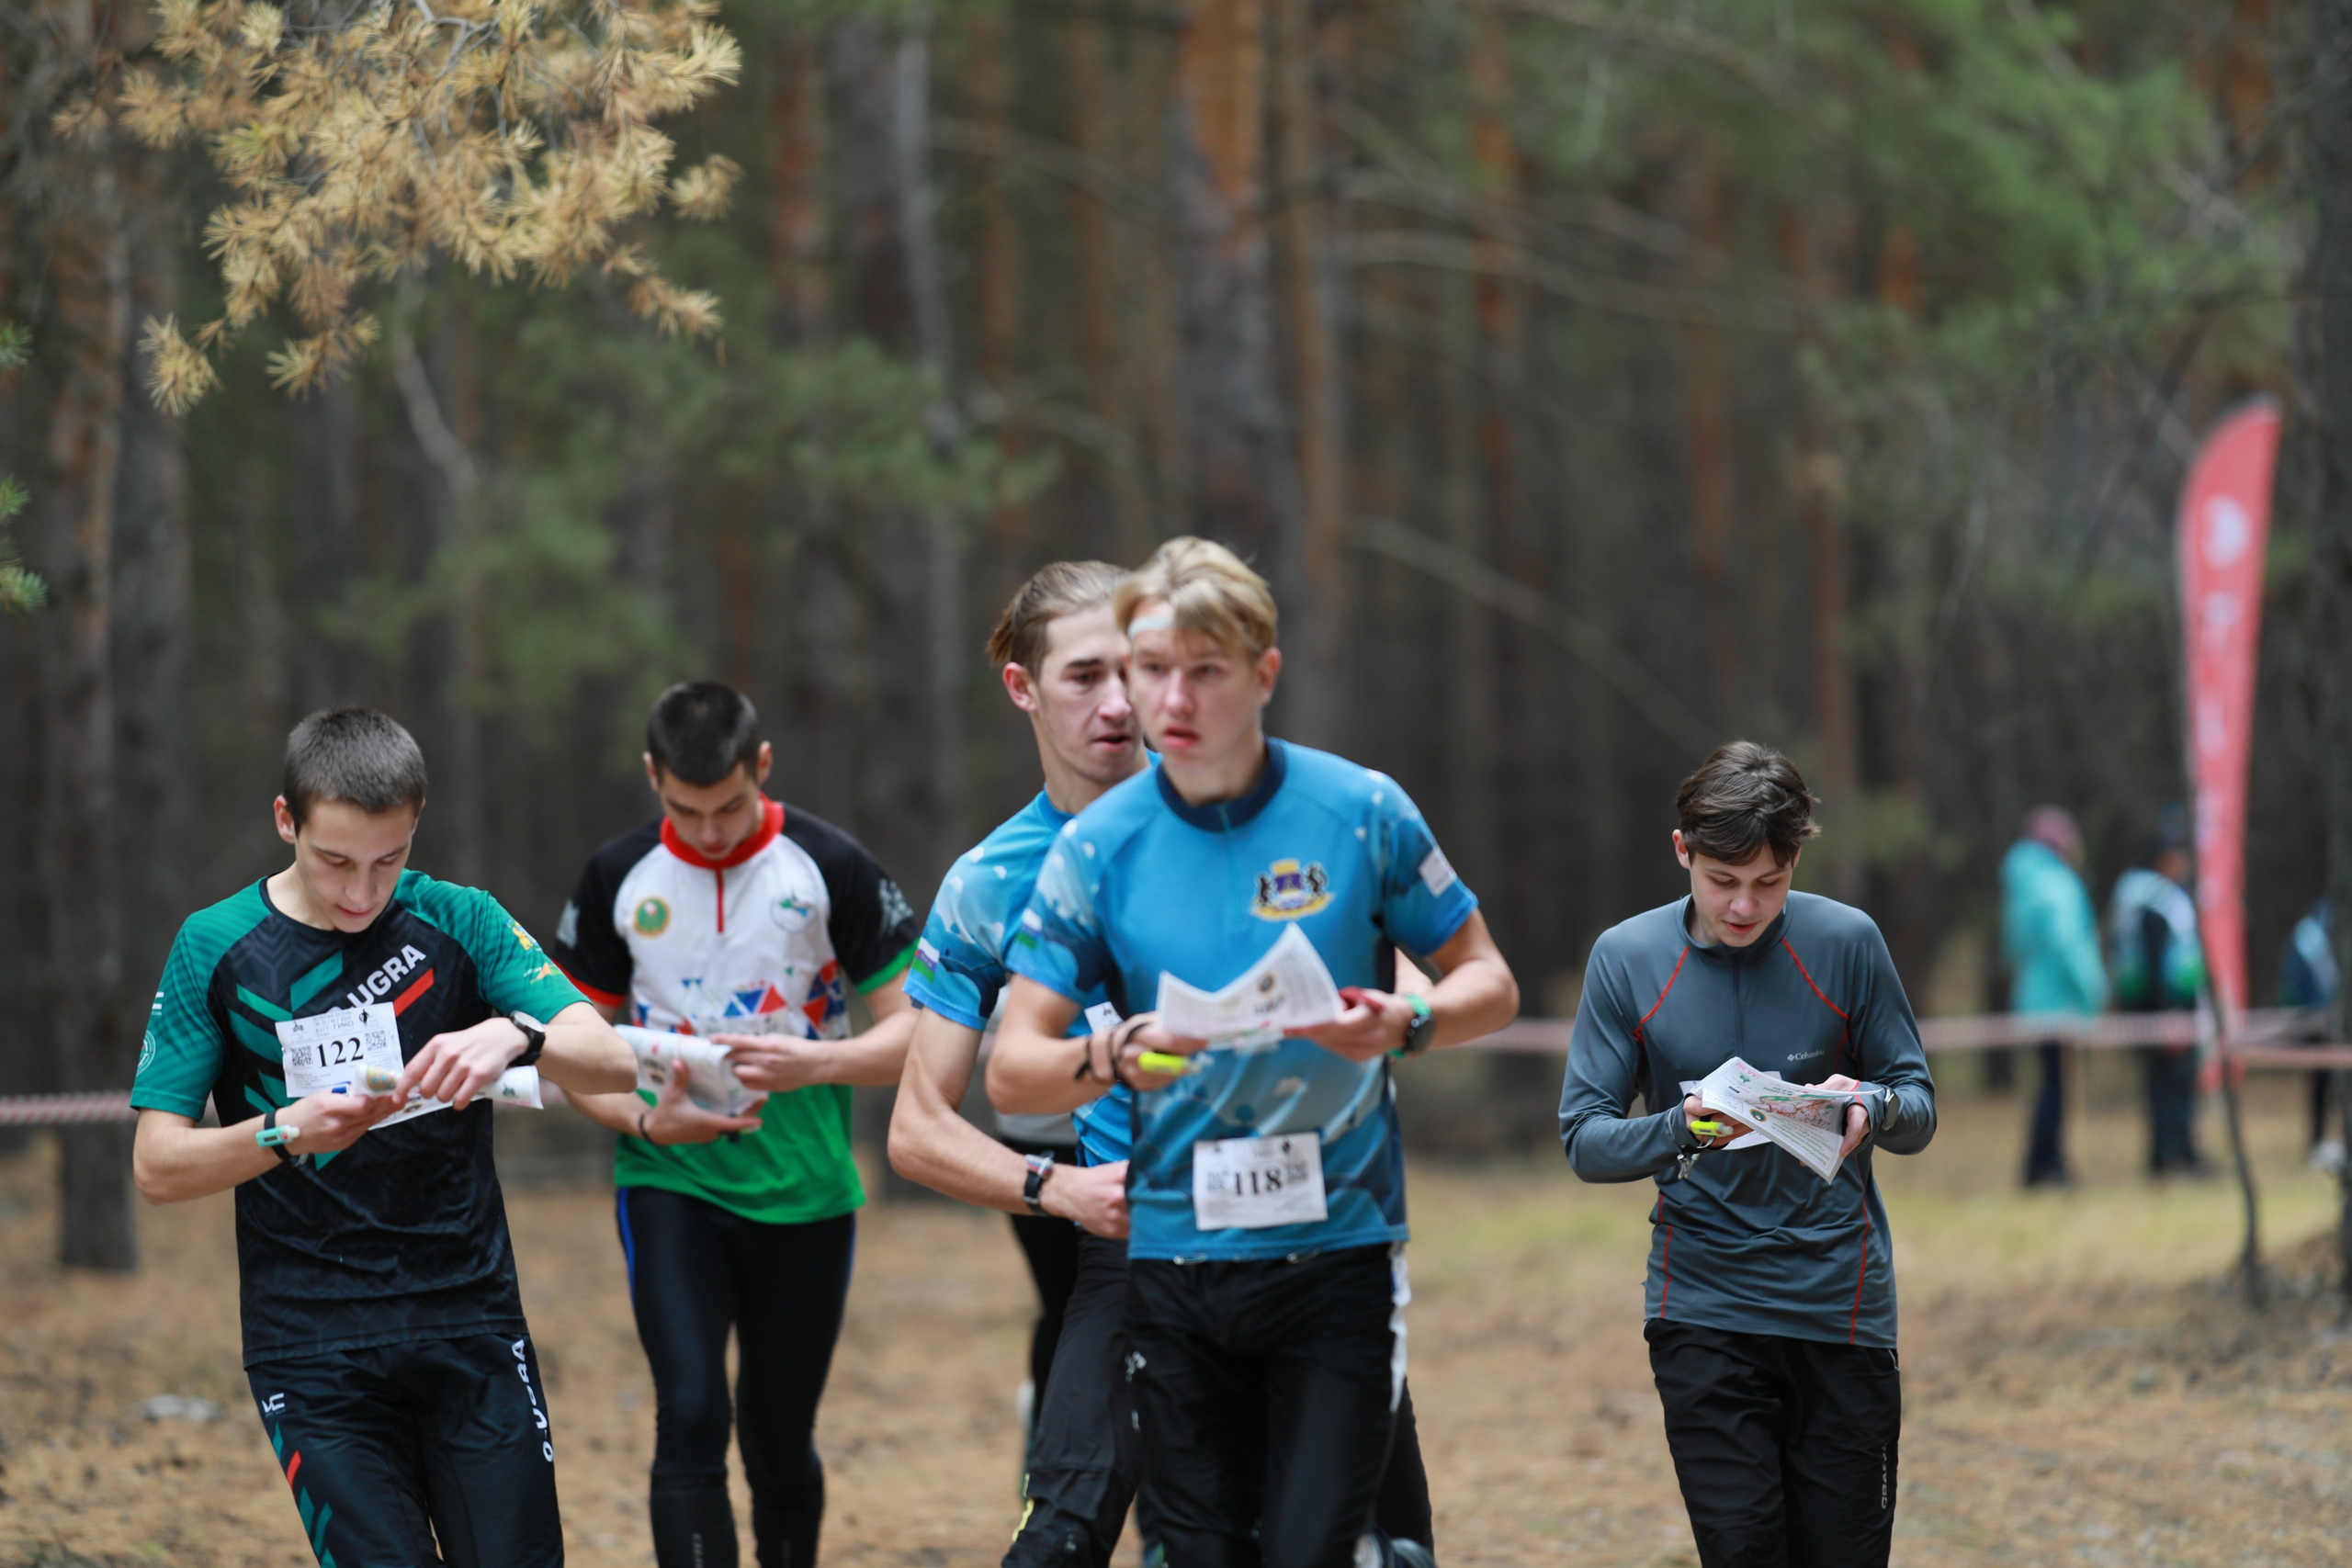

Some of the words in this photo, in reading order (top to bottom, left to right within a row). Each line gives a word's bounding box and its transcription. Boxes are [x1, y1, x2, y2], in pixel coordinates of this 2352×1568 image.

[317, 1037, 364, 1067] 122
[1794, 1049, 1825, 1060] Columbia
[1235, 1168, 1283, 1196] 118
